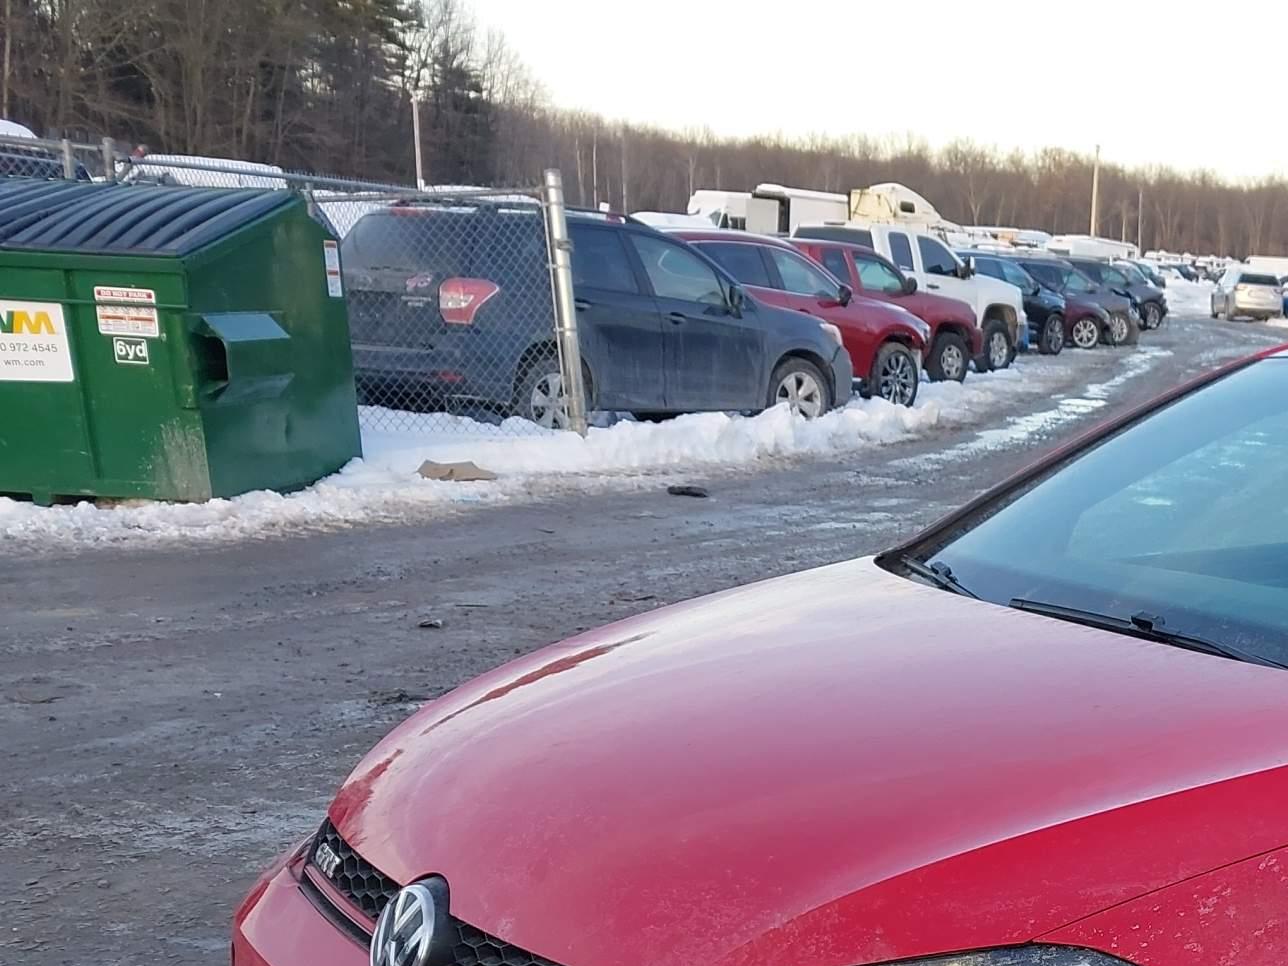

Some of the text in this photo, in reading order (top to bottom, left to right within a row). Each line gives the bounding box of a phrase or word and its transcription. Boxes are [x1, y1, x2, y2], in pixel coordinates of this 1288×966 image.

[9, 342, 29, 352] 972
[31, 343, 58, 353] 4545
[116, 340, 147, 360] 6yd
